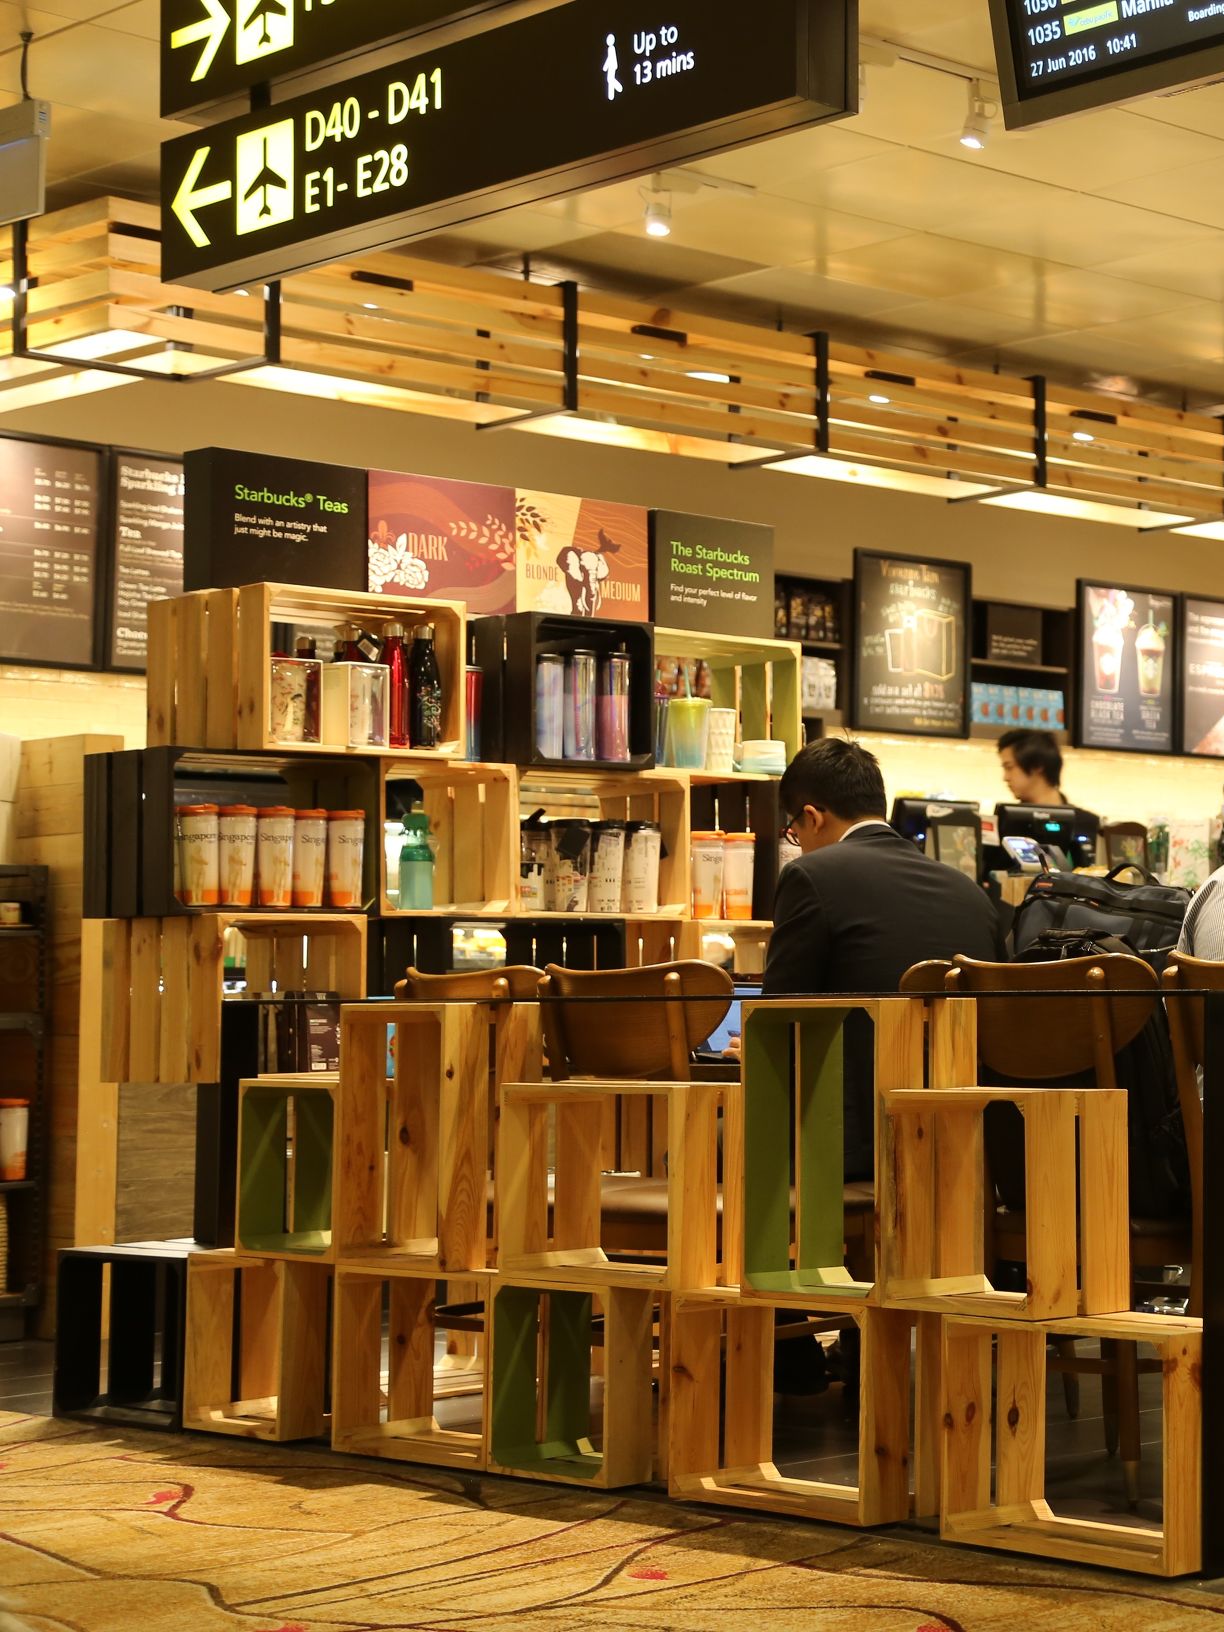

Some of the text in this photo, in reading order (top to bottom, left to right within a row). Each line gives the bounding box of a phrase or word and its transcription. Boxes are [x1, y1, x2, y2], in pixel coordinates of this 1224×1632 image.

[633, 26, 678, 57] Up to
[1027, 20, 1061, 46] 1035
[1079, 16, 1094, 26] cebu
[1030, 33, 1137, 77] 27 Jun 2016 10:41
[633, 51, 695, 85] 13 mins
[305, 97, 360, 152] D40
[388, 68, 442, 125] D41
[356, 144, 409, 199] E28
[316, 495, 349, 514] Teas
[233, 525, 309, 543] just might be magic.
[234, 513, 328, 533] Blend with an artistry that
[408, 532, 448, 562] DARK
[670, 541, 750, 565] The Starbucks
[525, 563, 559, 583] BLONDE
[670, 558, 760, 583] Roast Spectrum
[600, 580, 641, 602] MEDIUM
[670, 583, 684, 592] Find
[684, 586, 698, 595] your
[698, 587, 719, 597] perfect
[734, 591, 741, 600] of
[670, 594, 682, 602] and
